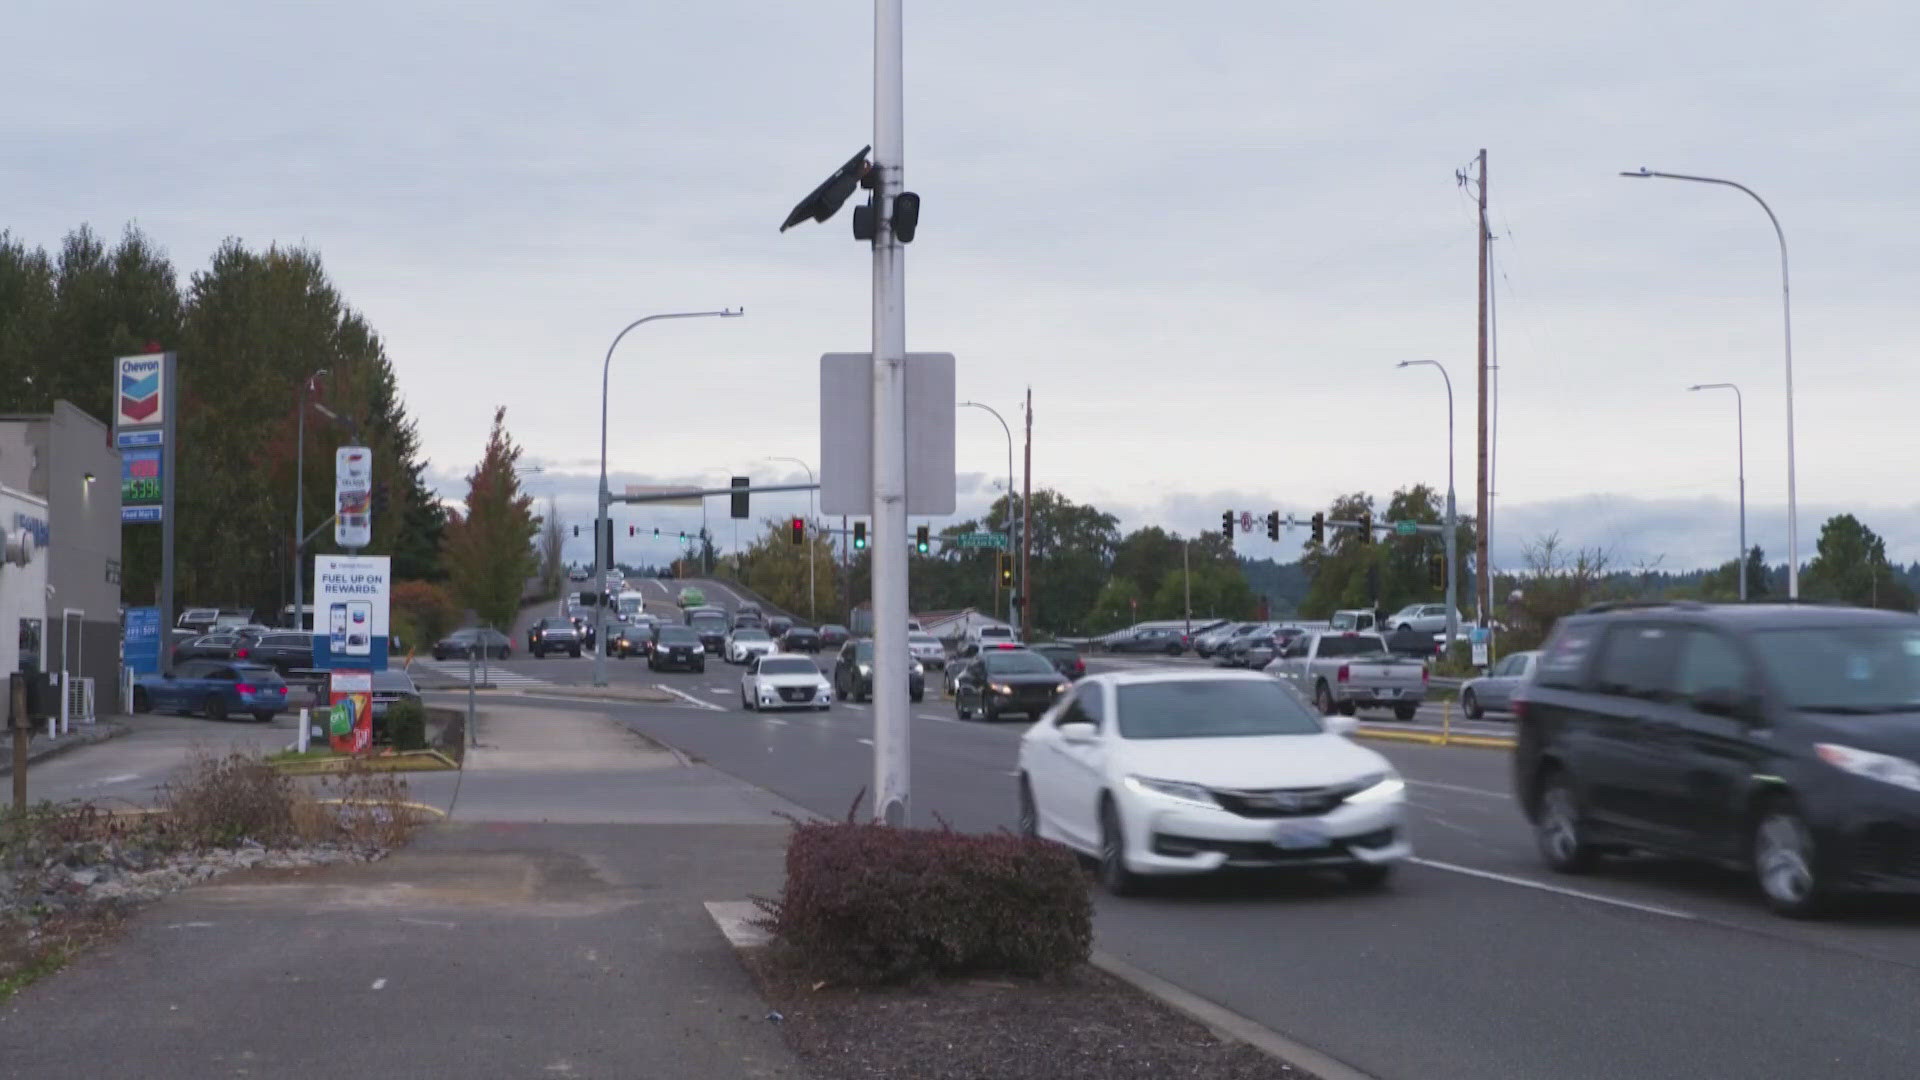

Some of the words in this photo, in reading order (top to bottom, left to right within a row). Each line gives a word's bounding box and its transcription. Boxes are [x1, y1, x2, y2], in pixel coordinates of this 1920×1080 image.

[122, 360, 159, 373] Chevron
[322, 574, 347, 584] FUEL
[350, 574, 365, 584] UP
[367, 574, 382, 584] ON
